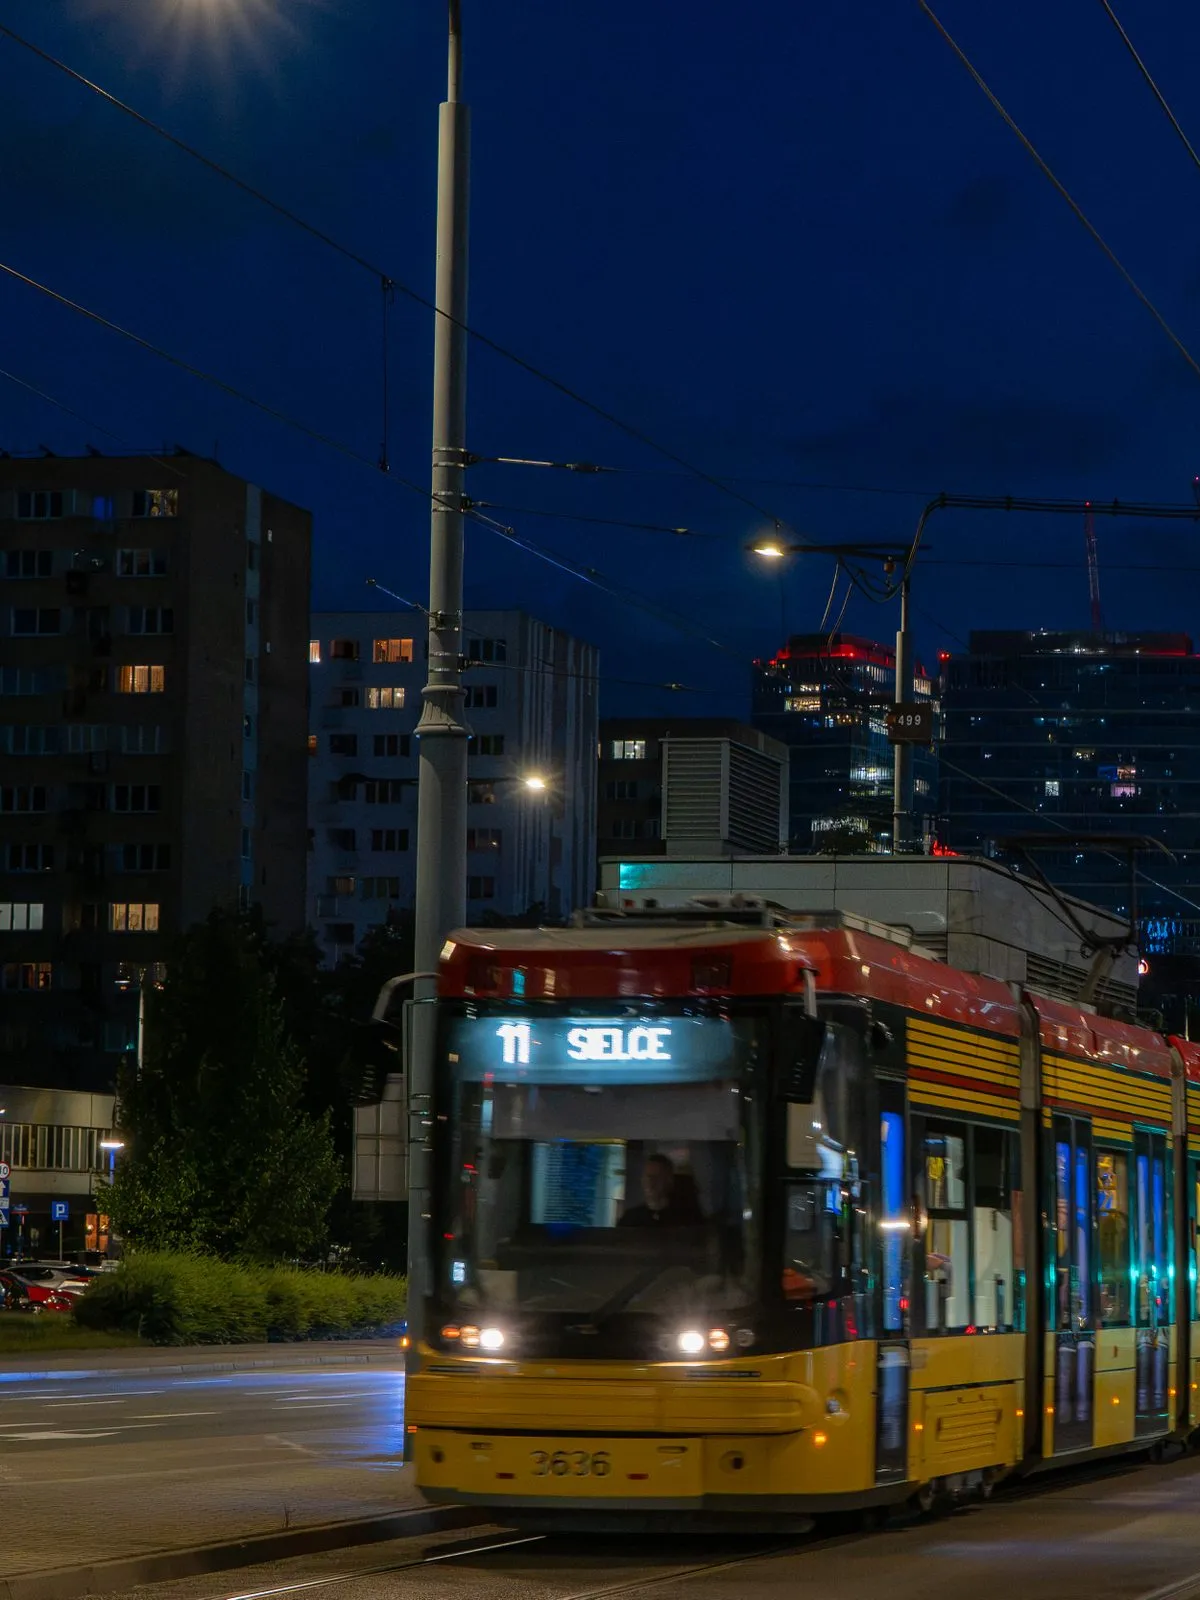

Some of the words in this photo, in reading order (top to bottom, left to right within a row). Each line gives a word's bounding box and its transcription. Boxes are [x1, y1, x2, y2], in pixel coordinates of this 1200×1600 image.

[898, 714, 921, 726] 499
[497, 1024, 530, 1063] 11
[530, 1450, 611, 1477] 3636
